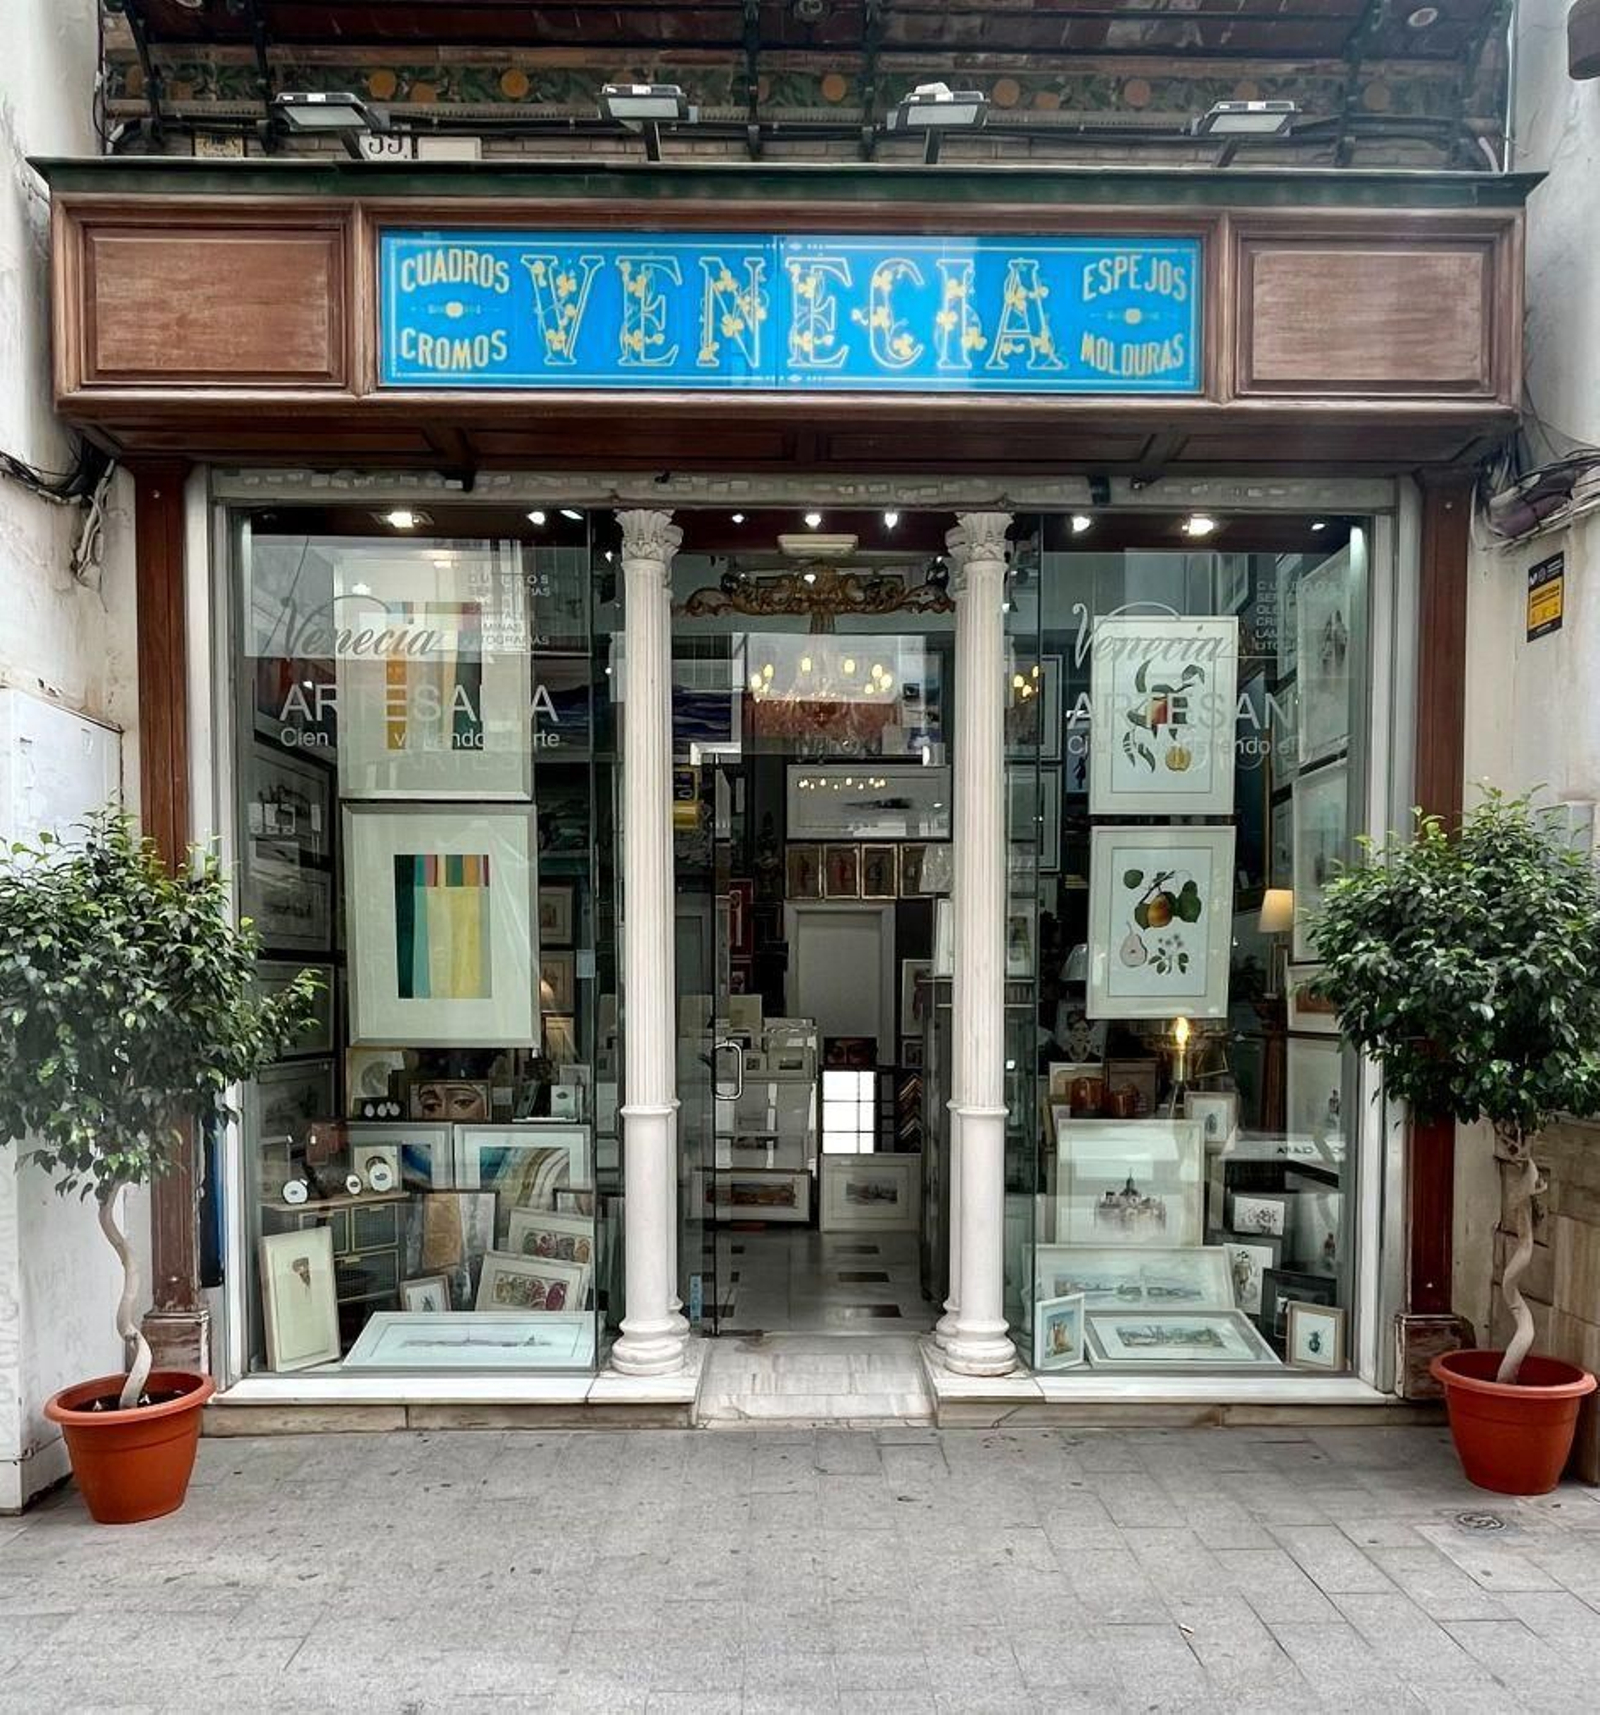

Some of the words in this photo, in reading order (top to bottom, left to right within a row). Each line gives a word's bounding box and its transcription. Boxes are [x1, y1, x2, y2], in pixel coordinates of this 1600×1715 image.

[400, 248, 510, 294] CUADROS
[1082, 255, 1188, 302] ESPEJOS
[520, 254, 1068, 372] VENECIA
[400, 327, 508, 371] CROMOS
[278, 593, 437, 661] Venecia
[1072, 600, 1231, 669] Venecia
[279, 685, 558, 722] ARESAA
[280, 726, 329, 748] Cien
